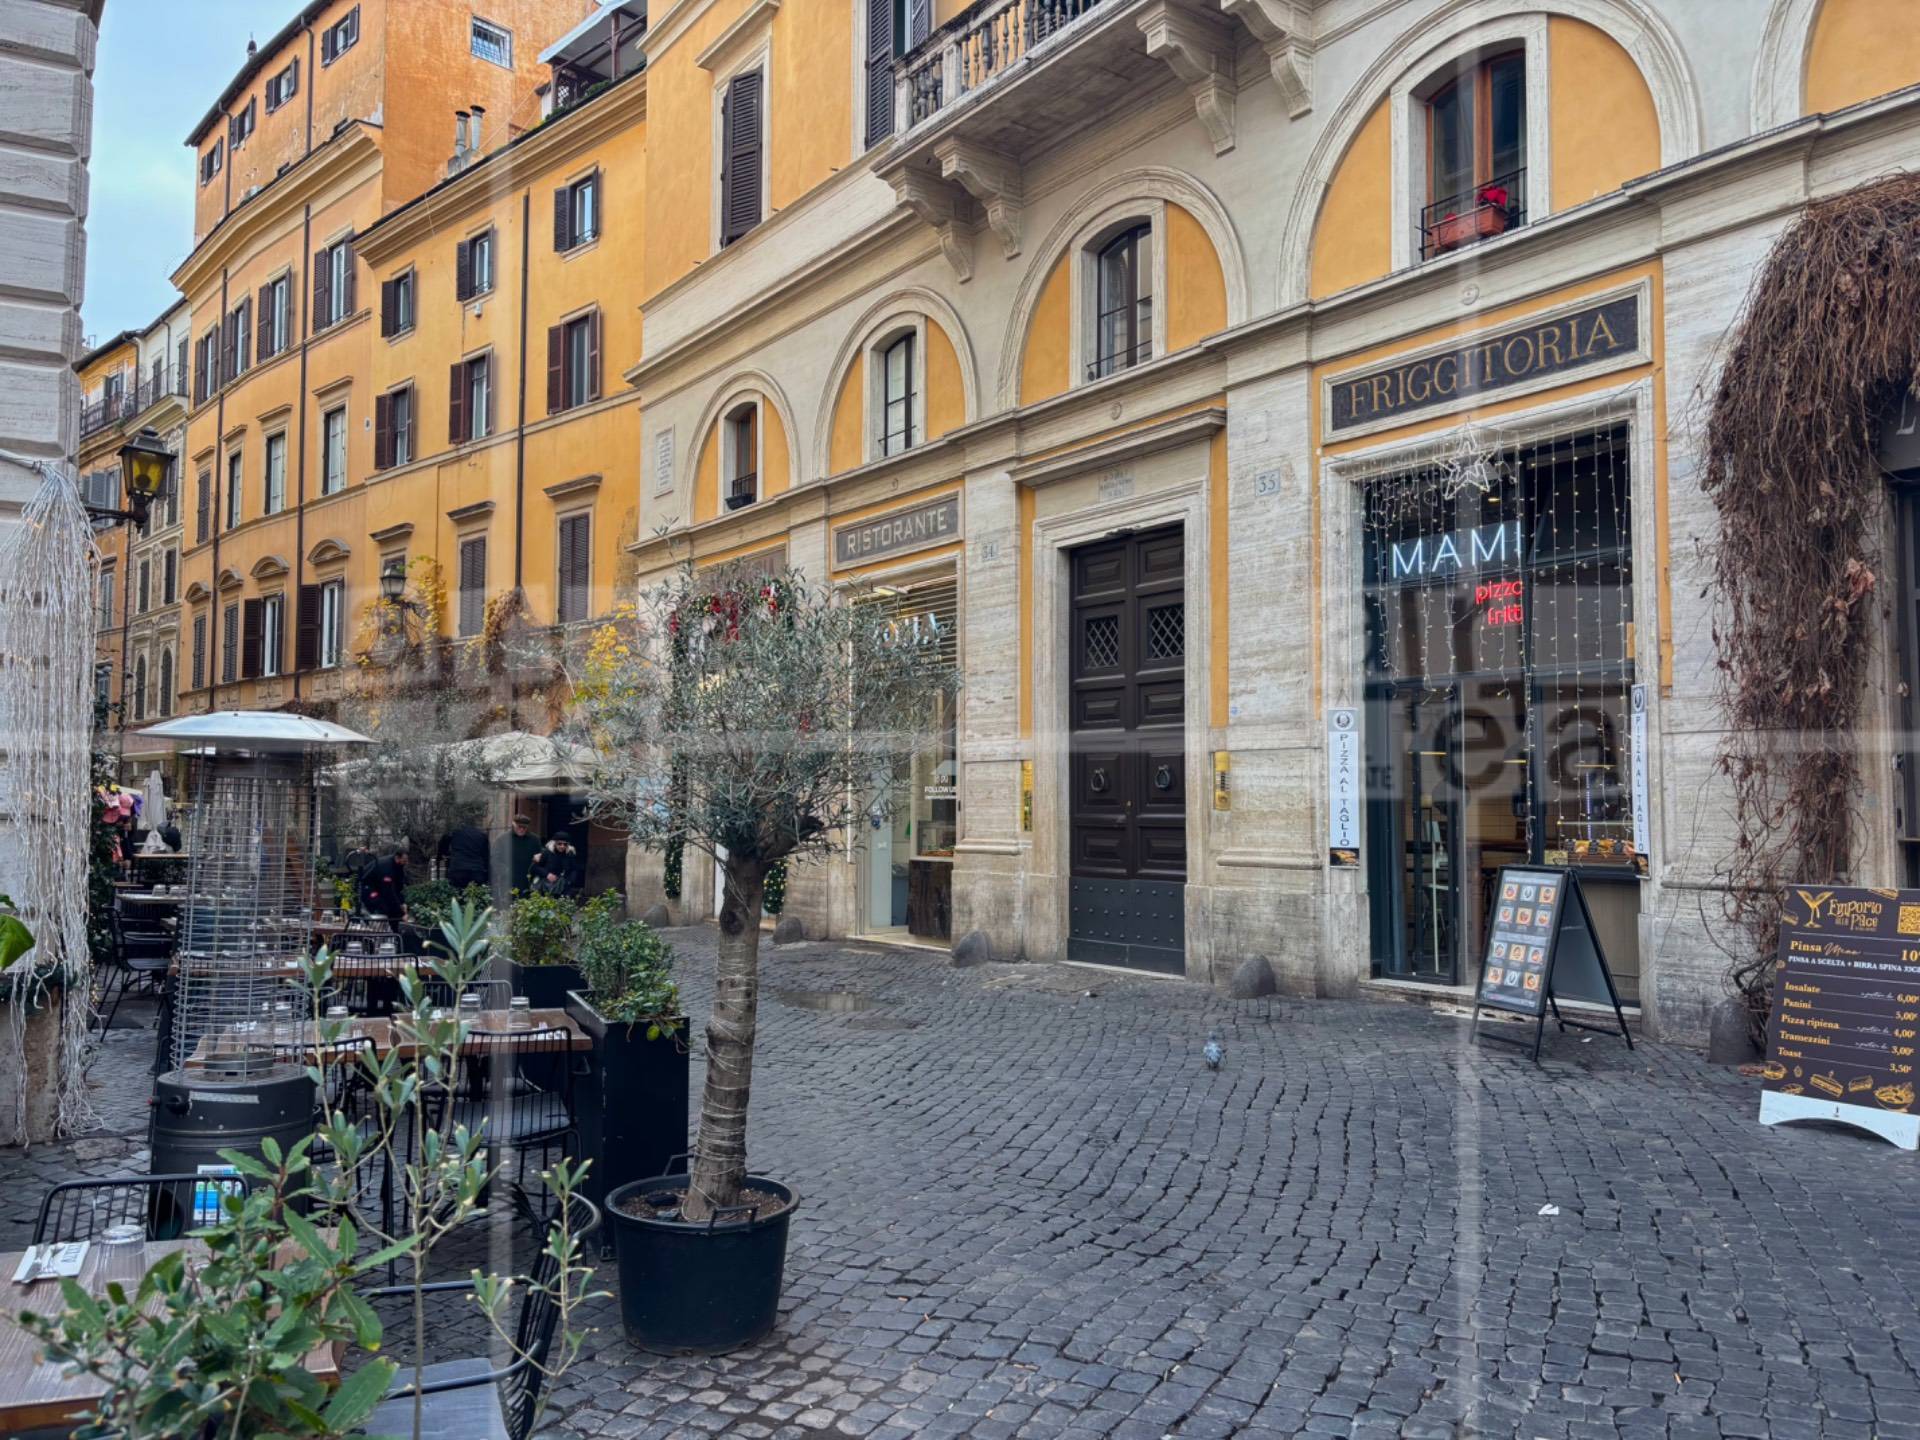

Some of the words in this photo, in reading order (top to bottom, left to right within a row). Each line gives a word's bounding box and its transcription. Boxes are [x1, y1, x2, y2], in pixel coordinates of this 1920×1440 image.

[1350, 313, 1620, 418] FRIGGITORIA
[1258, 474, 1277, 493] 35
[847, 506, 948, 554] RISTORANTE
[1393, 520, 1521, 579] MAMI
[1340, 733, 1349, 773] PIZZA
[1340, 777, 1349, 793] AL
[1636, 770, 1641, 788] AL
[1339, 798, 1350, 846] TAGLIO
[1790, 940, 1822, 953] Pinsa
[1788, 955, 1810, 964] PINSA
[1818, 958, 1846, 968] SCELTA
[1853, 961, 1878, 970] BIRRA
[1879, 964, 1903, 973] SPINA
[1902, 949, 1920, 962] 10
[1784, 981, 1821, 994] Insalate
[1783, 997, 1813, 1010] Panini
[1781, 1013, 1805, 1025] Pizza
[1806, 1017, 1841, 1029] ripiena
[1779, 1030, 1831, 1046] Tramezzini
[1778, 1047, 1803, 1059] Toast
